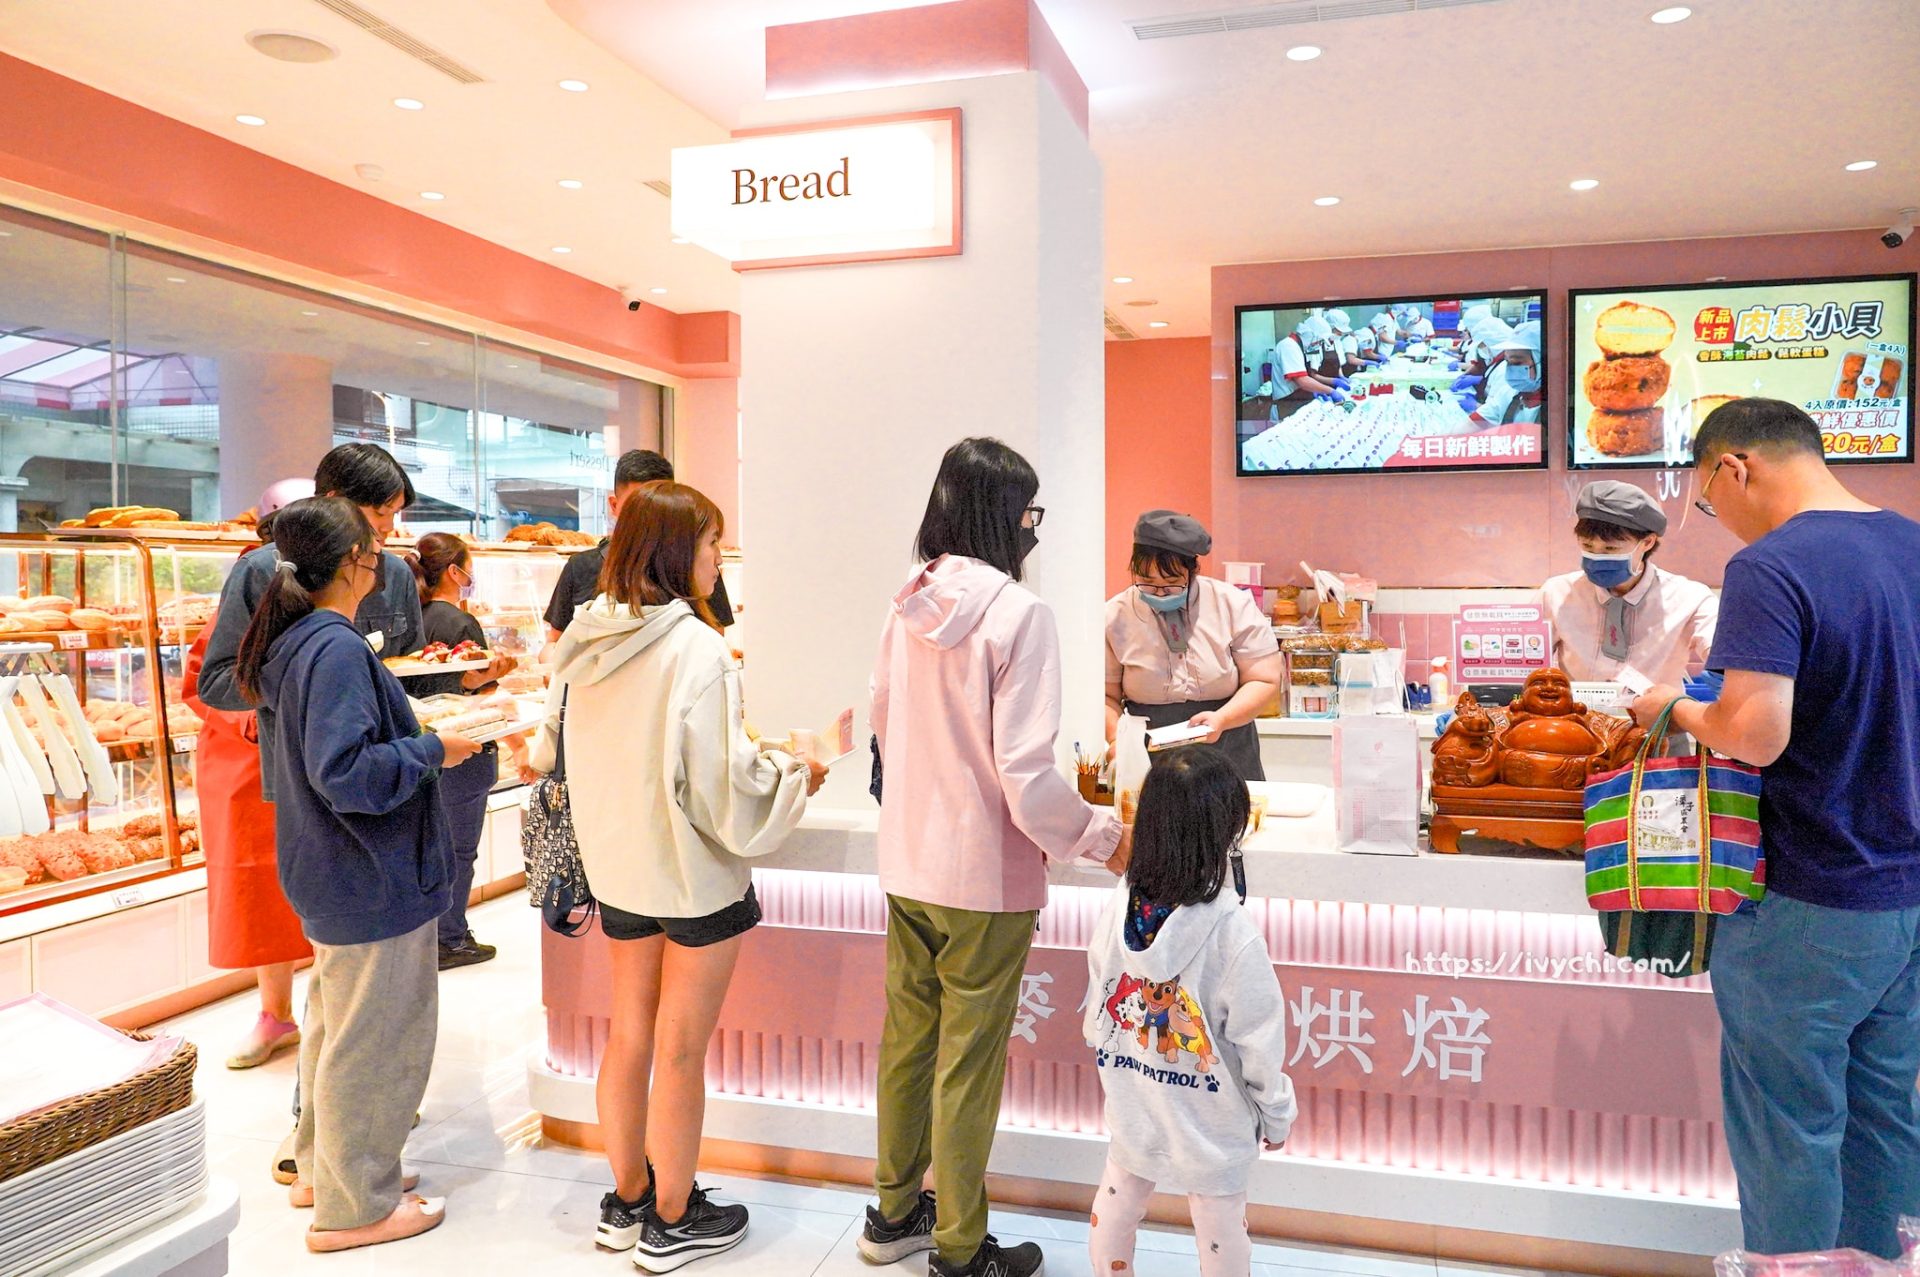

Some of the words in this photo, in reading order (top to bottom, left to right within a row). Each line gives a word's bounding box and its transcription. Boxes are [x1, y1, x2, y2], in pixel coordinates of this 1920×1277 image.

[731, 157, 852, 205] Bread
[1698, 307, 1731, 325] 新品
[1736, 302, 1882, 342] 肉鬆小貝
[1696, 326, 1729, 342] 上市
[1401, 435, 1535, 458] 每日新鮮製作
[1113, 1055, 1141, 1072] PAW
[1143, 1064, 1200, 1089] PATROL
